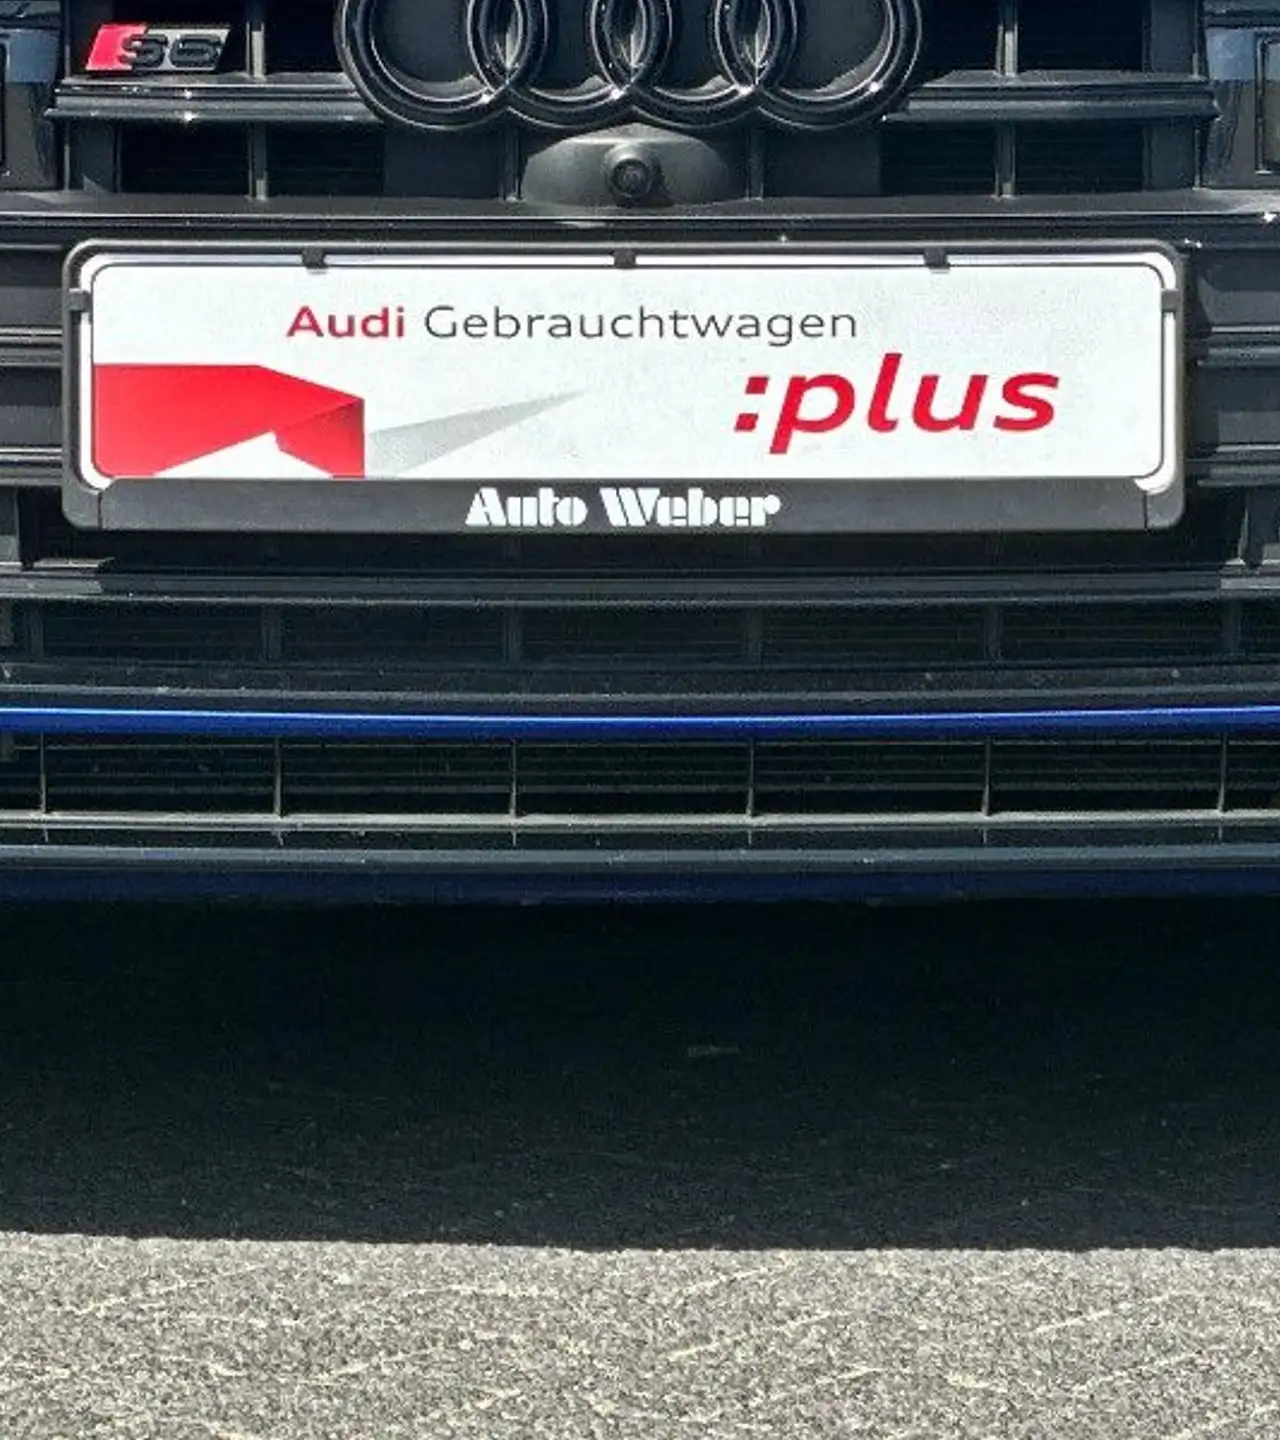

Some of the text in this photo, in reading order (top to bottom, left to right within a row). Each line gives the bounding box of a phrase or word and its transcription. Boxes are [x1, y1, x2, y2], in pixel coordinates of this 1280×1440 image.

[116, 32, 225, 69] S6
[287, 304, 858, 349] Audi Gebrauchtwagen
[733, 350, 1061, 457] :plus
[463, 486, 784, 529] Auto Weber
